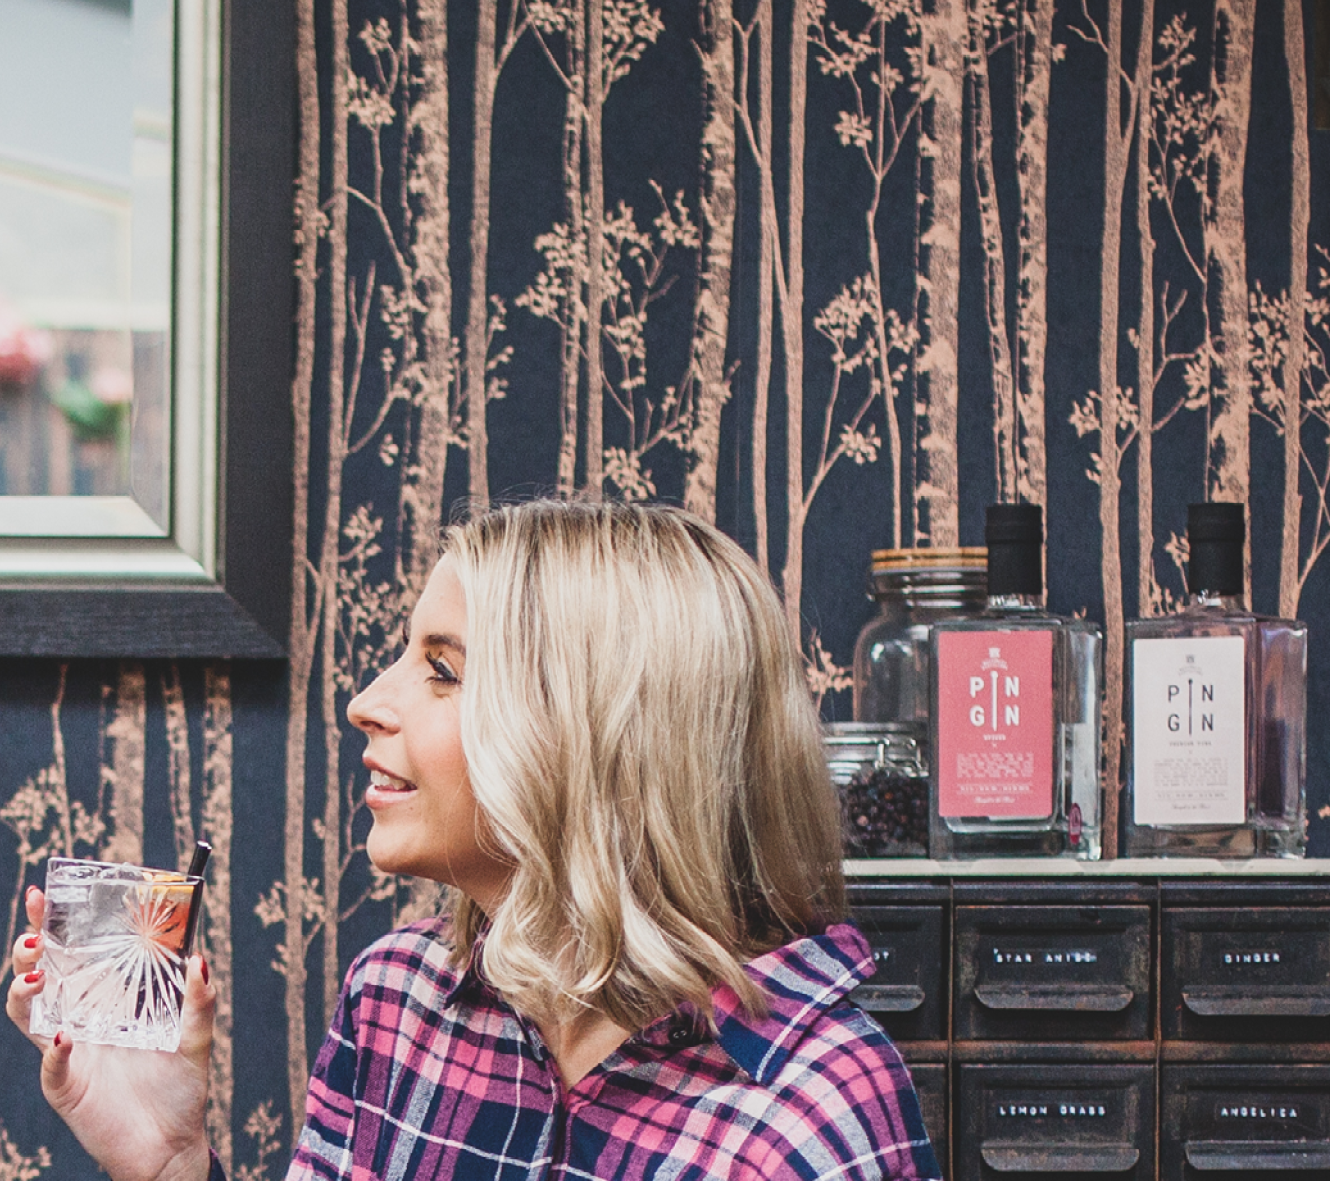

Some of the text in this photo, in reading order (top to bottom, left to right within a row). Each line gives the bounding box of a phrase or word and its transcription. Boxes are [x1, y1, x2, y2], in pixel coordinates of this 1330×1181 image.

[996, 952, 1032, 963] STAR
[1224, 952, 1280, 964] GINGER
[999, 1105, 1106, 1117] LEMON GRASS
[1220, 1106, 1298, 1118] ANGELICA
